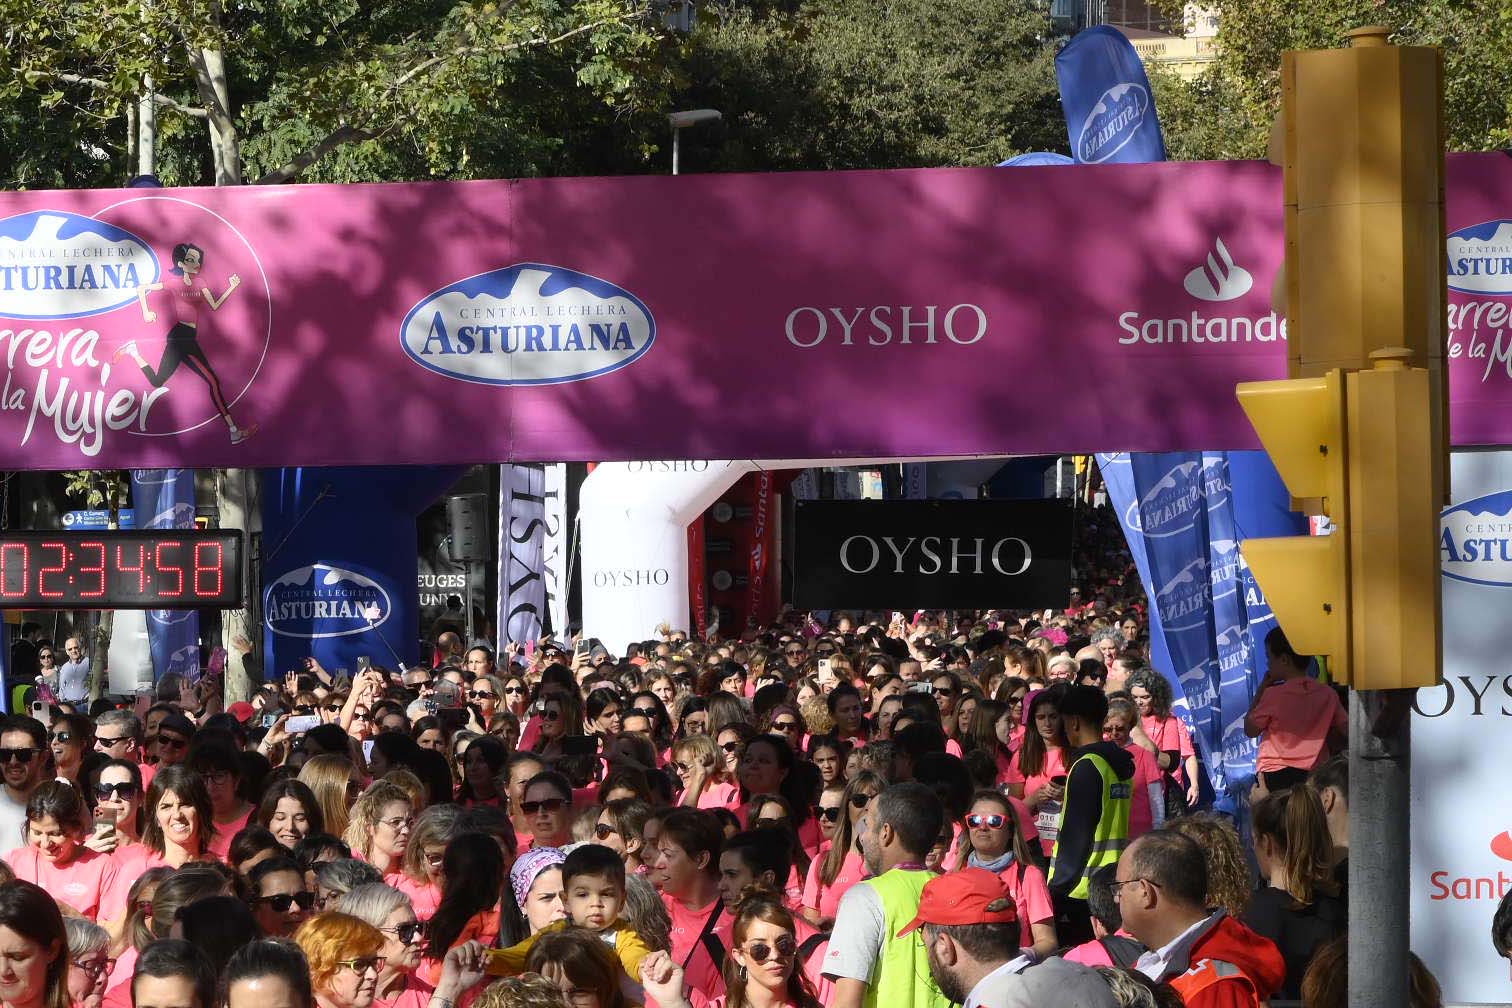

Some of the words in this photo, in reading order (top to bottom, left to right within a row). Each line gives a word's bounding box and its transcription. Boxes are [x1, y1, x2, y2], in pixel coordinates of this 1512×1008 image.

[63, 245, 136, 258] LECHERA
[421, 310, 636, 355] ASTURIANA
[459, 305, 539, 319] CENTRAL
[546, 303, 628, 317] LECHERA
[785, 302, 988, 347] OYSHO
[1468, 331, 1486, 358] la
[1, 372, 26, 411] la
[20, 363, 170, 457] Mujer
[0, 542, 223, 598] 02:34:58
[839, 534, 1032, 577] OYSHO
[593, 568, 669, 588] OYSHO
